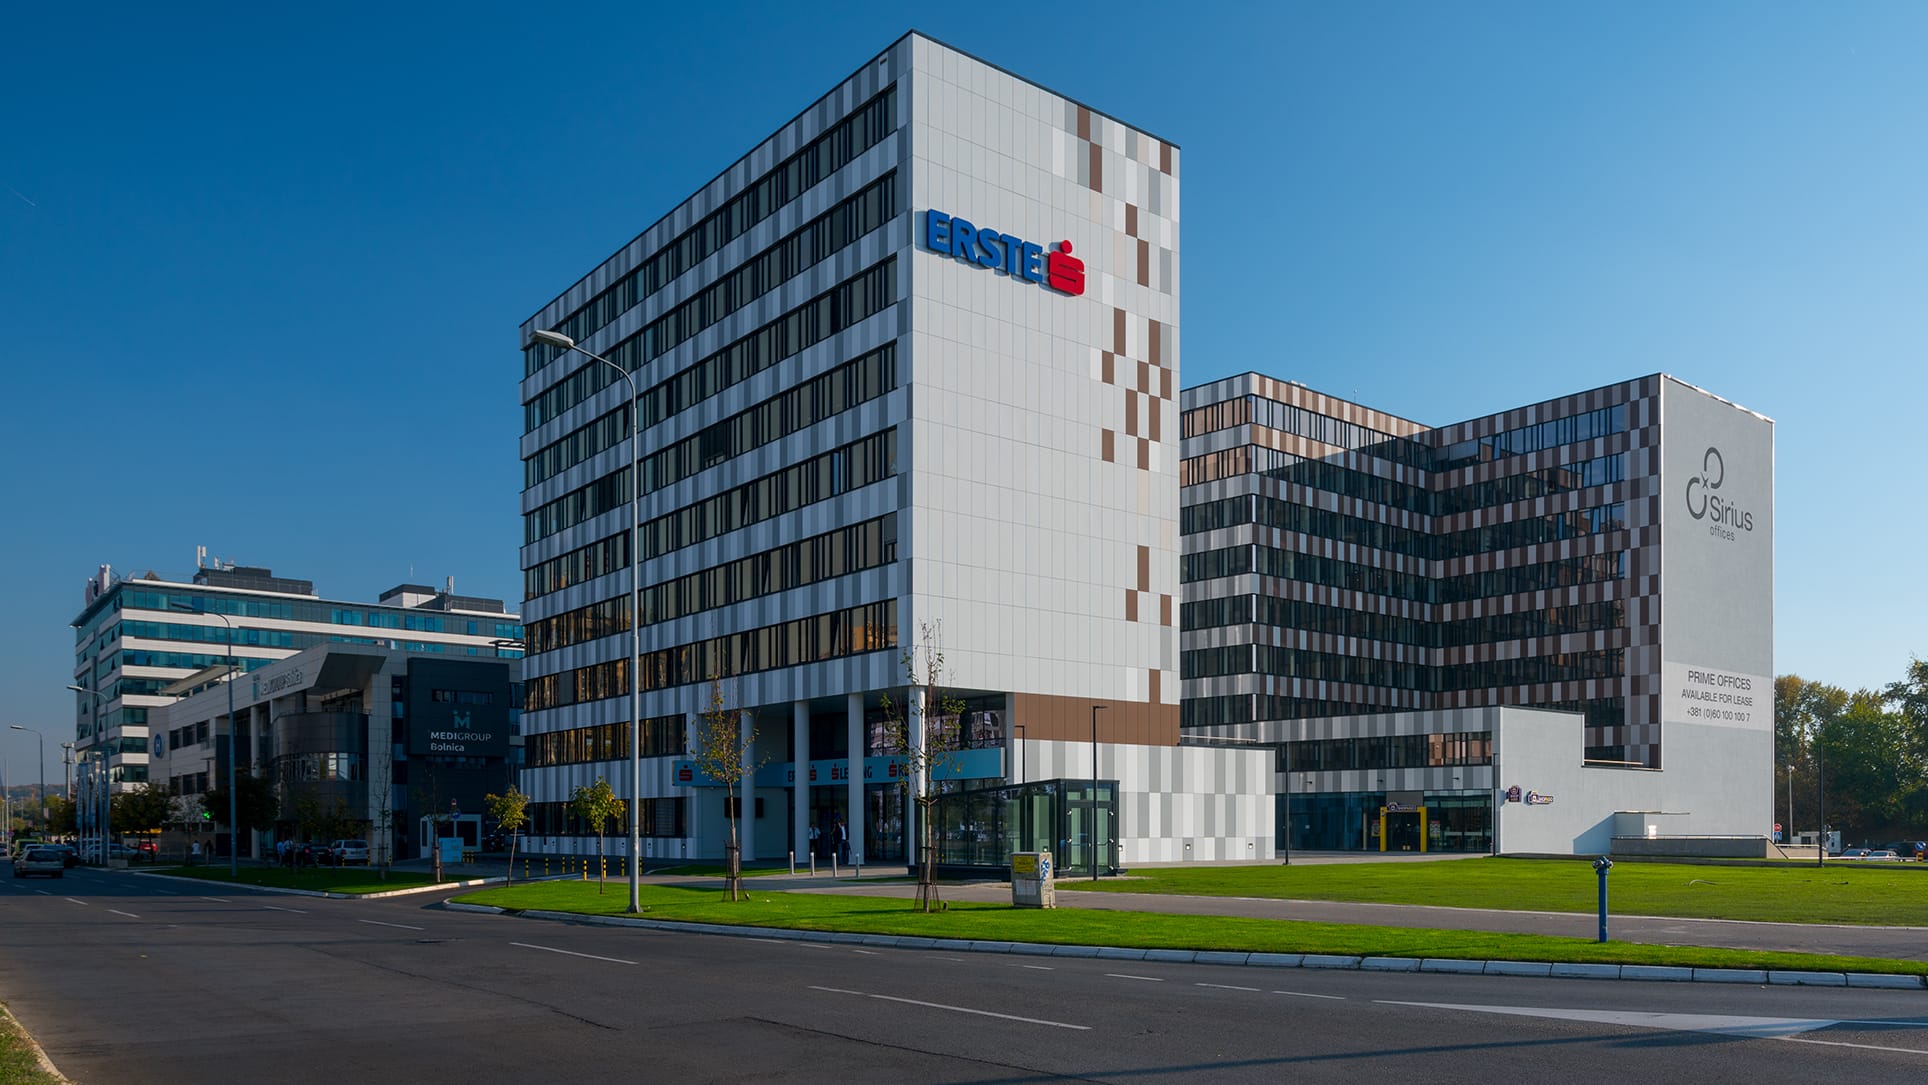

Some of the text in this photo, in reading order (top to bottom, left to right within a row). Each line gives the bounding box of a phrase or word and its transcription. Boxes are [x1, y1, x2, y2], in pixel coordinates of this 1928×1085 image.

[927, 208, 1043, 283] ERSTE
[1710, 495, 1753, 532] Sirius
[1710, 525, 1735, 541] offices
[1688, 670, 1751, 690] PRIME OFFICES
[1681, 689, 1753, 707] AVAILABLE FOR LEASE
[1687, 707, 1701, 717] +381
[430, 731, 492, 741] MEDIGROUP
[430, 742, 465, 752] Bolnica
